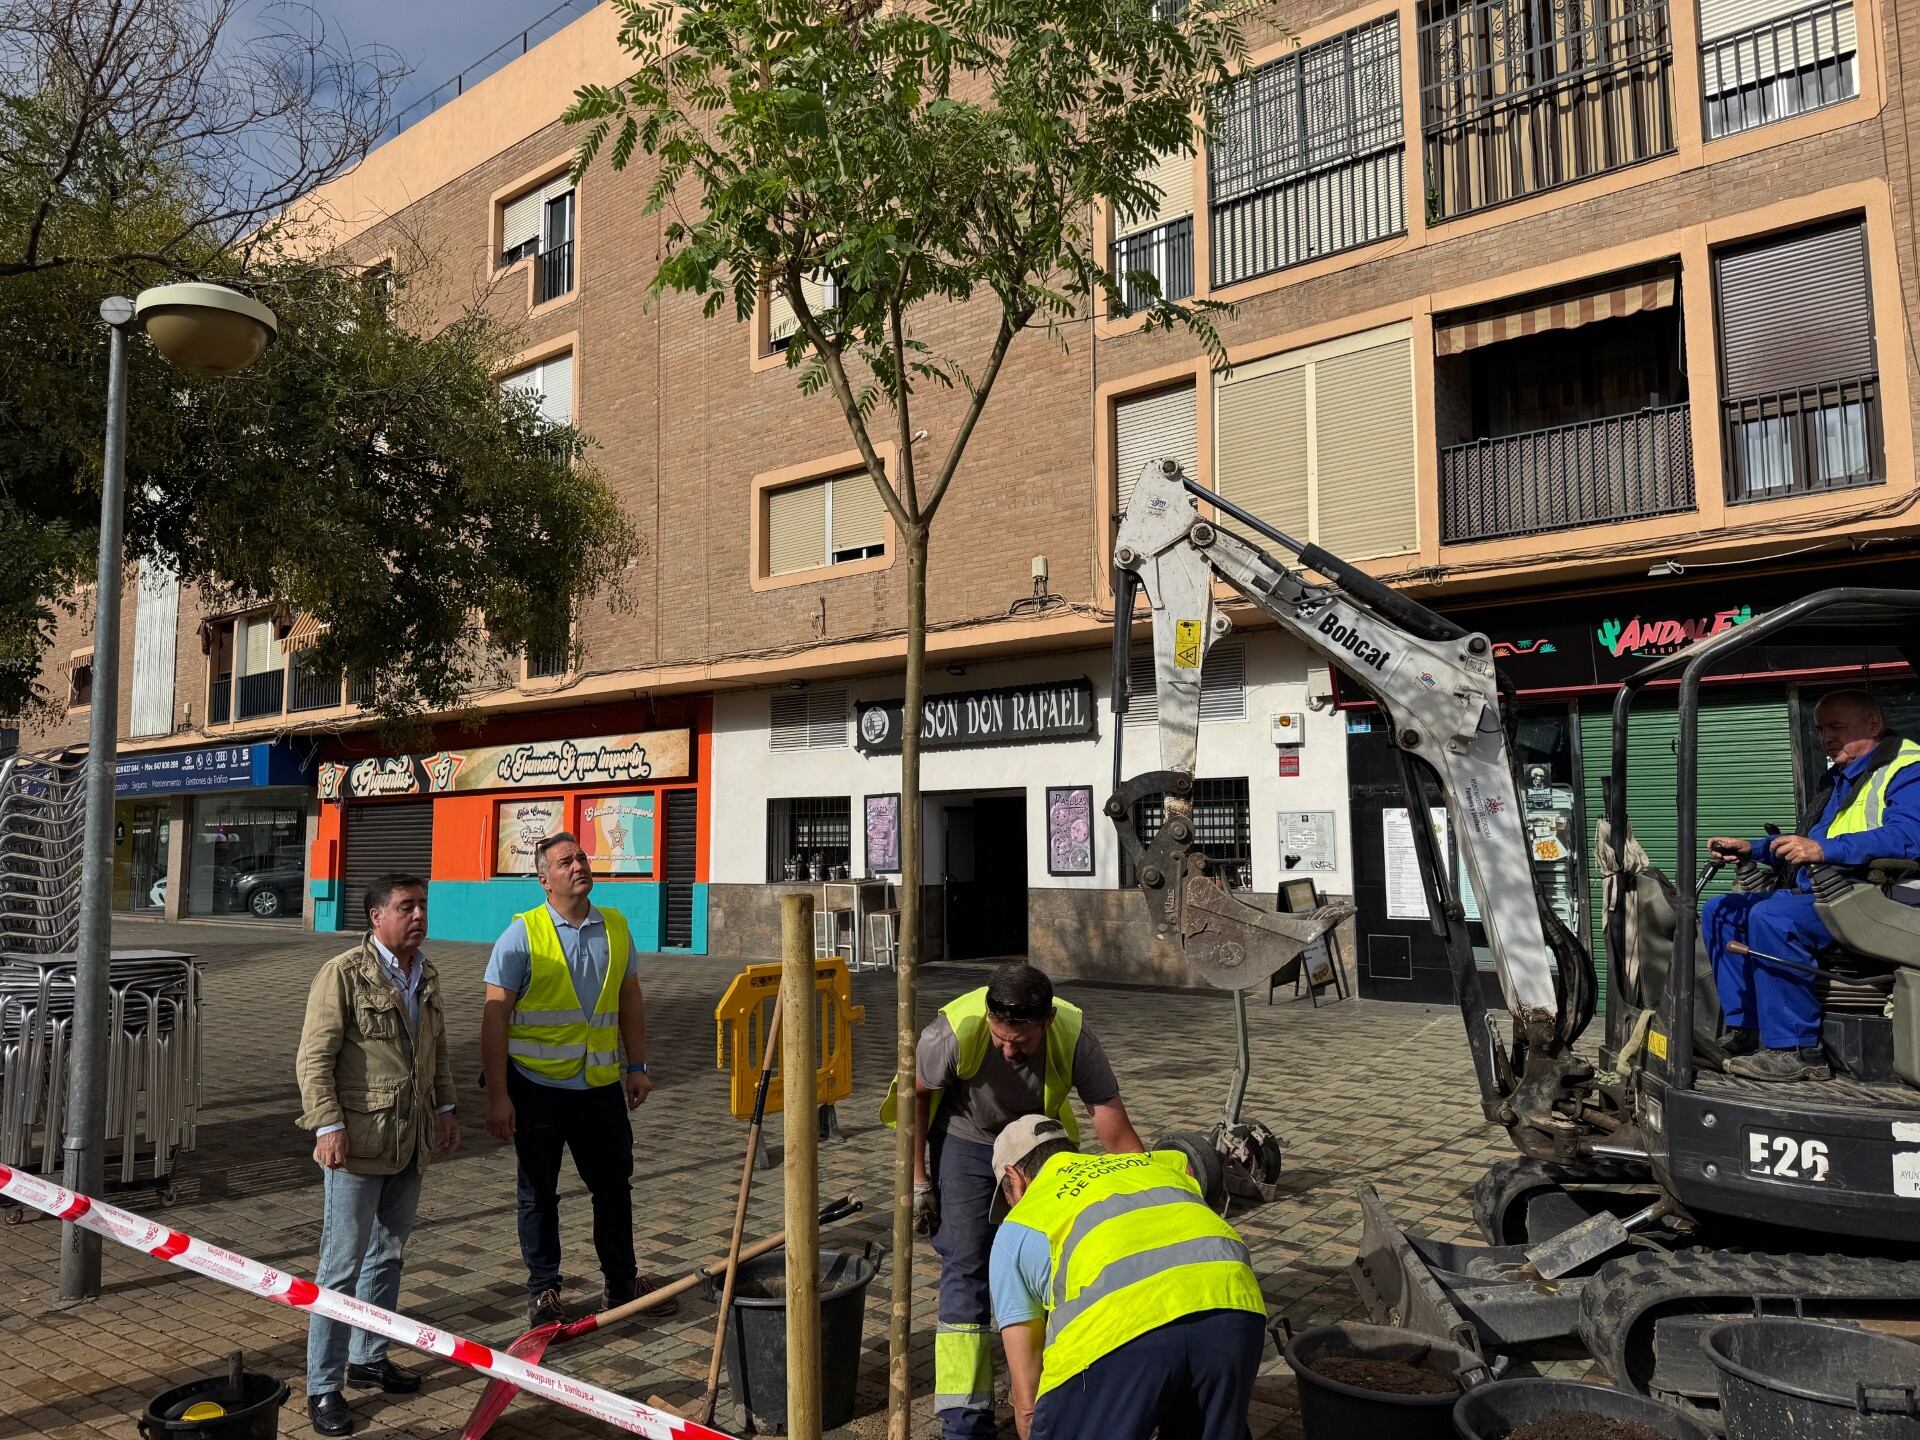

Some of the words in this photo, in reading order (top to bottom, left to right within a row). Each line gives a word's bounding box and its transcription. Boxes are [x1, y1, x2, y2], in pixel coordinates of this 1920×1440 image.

[1317, 612, 1392, 672] Bobcat
[901, 700, 958, 740] SON
[967, 694, 1004, 734] DON
[1012, 687, 1085, 731] RAFAEL
[1749, 1132, 1830, 1182] E26
[1070, 1180, 1089, 1198] DE
